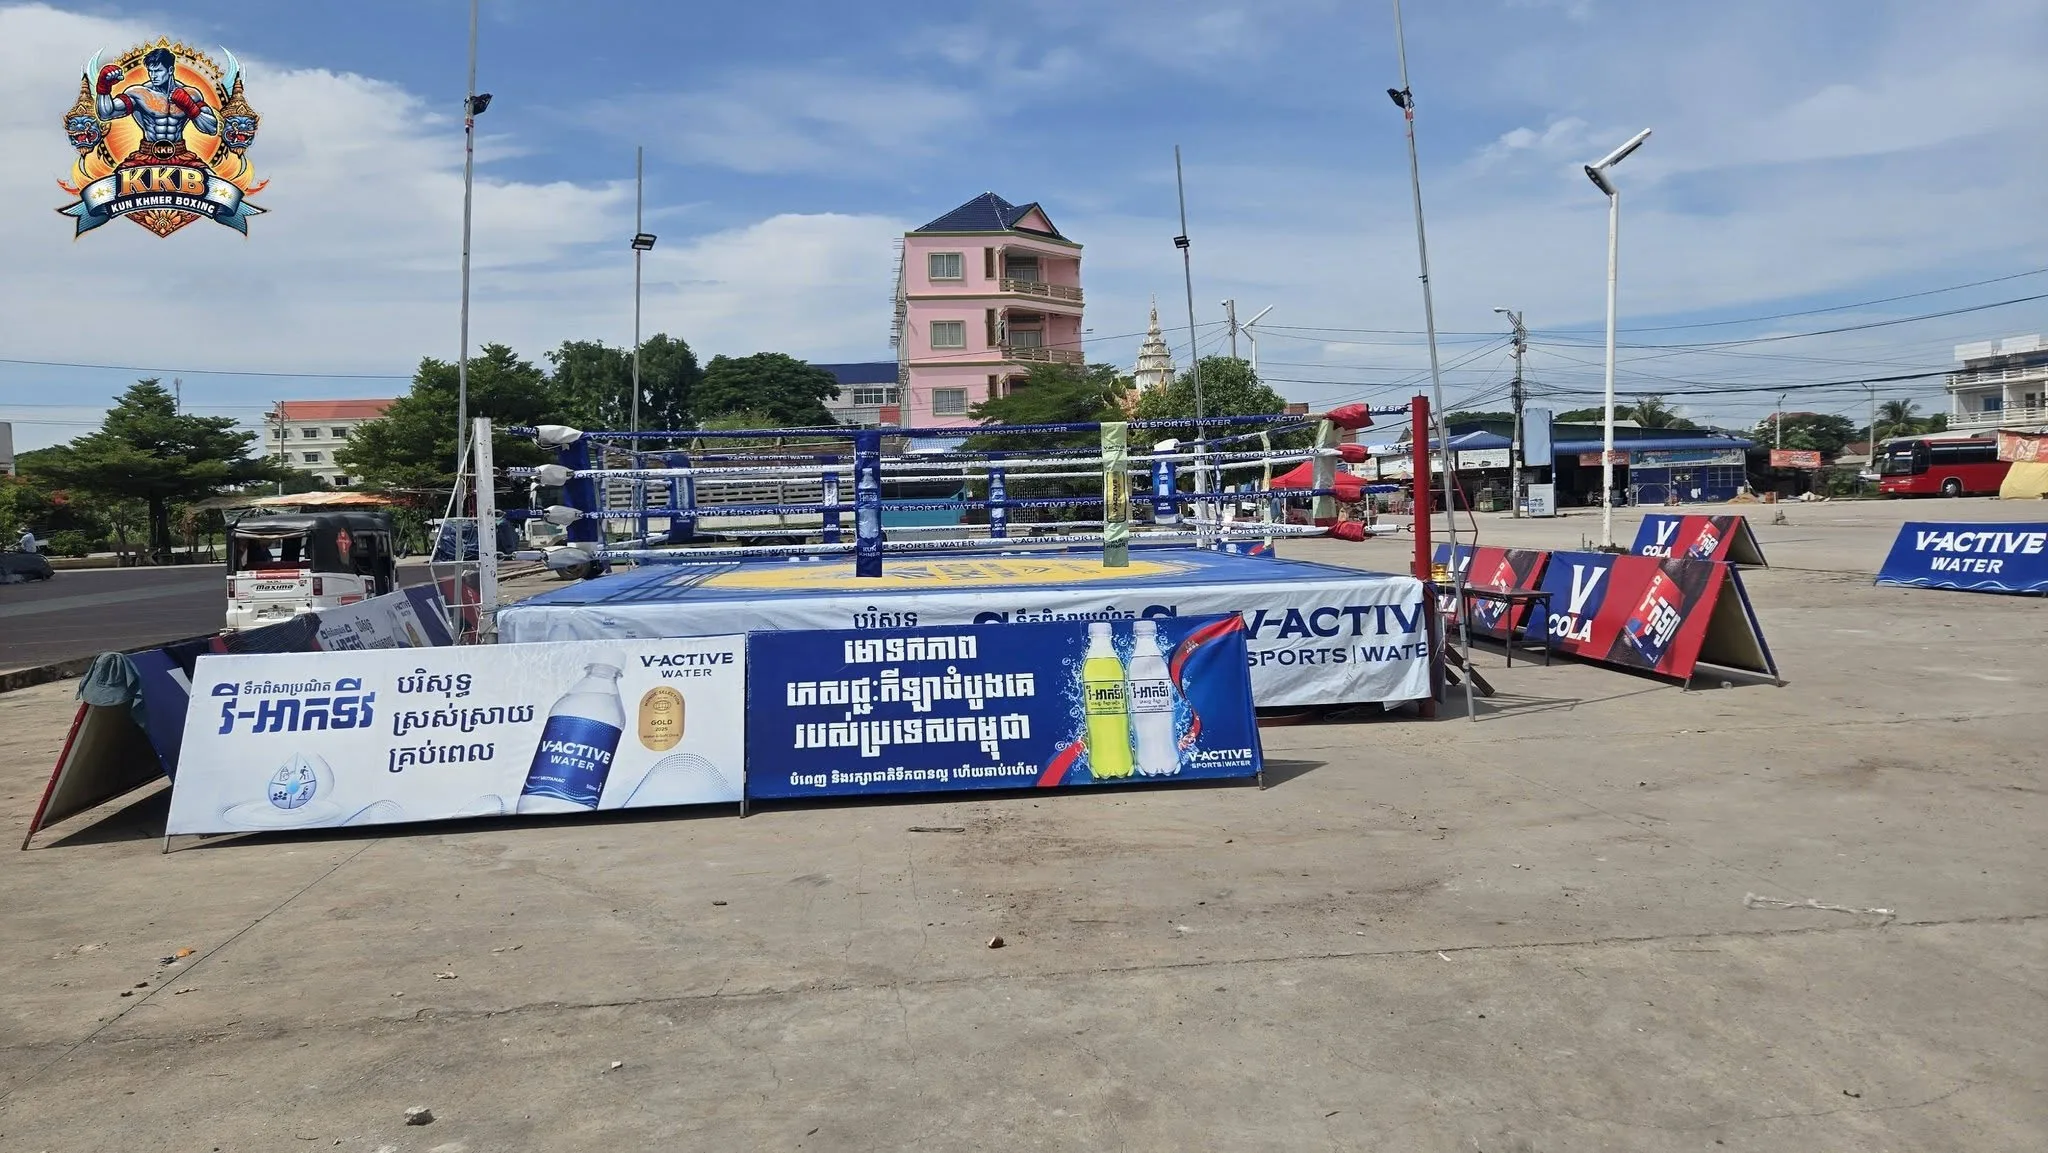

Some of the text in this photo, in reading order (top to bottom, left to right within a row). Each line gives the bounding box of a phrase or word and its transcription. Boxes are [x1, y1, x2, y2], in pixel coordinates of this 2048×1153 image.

[1266, 415, 1305, 423] V-ACTIV
[1656, 520, 1679, 545] V
[1915, 531, 2047, 554] V-ACTIVE
[1642, 545, 1673, 558] COLA
[1930, 557, 2004, 574] WATER
[1568, 565, 1608, 614] V
[1230, 602, 1427, 640] V-ACTIV
[1548, 614, 1593, 643] COLA
[640, 652, 734, 667] V-ACTIVE
[398, 668, 472, 698] បរិសុទ្ធ
[661, 668, 712, 678] WATER
[244, 679, 331, 696] ទឹកពិសាប្រណិត
[393, 703, 534, 737] ស្រស់ស្រាយ
[389, 740, 494, 773] គ្រប់ពេល
[541, 740, 611, 765] V-ACTIVE
[550, 755, 594, 771] WATER
[1187, 748, 1252, 762] V-ACTIVE
